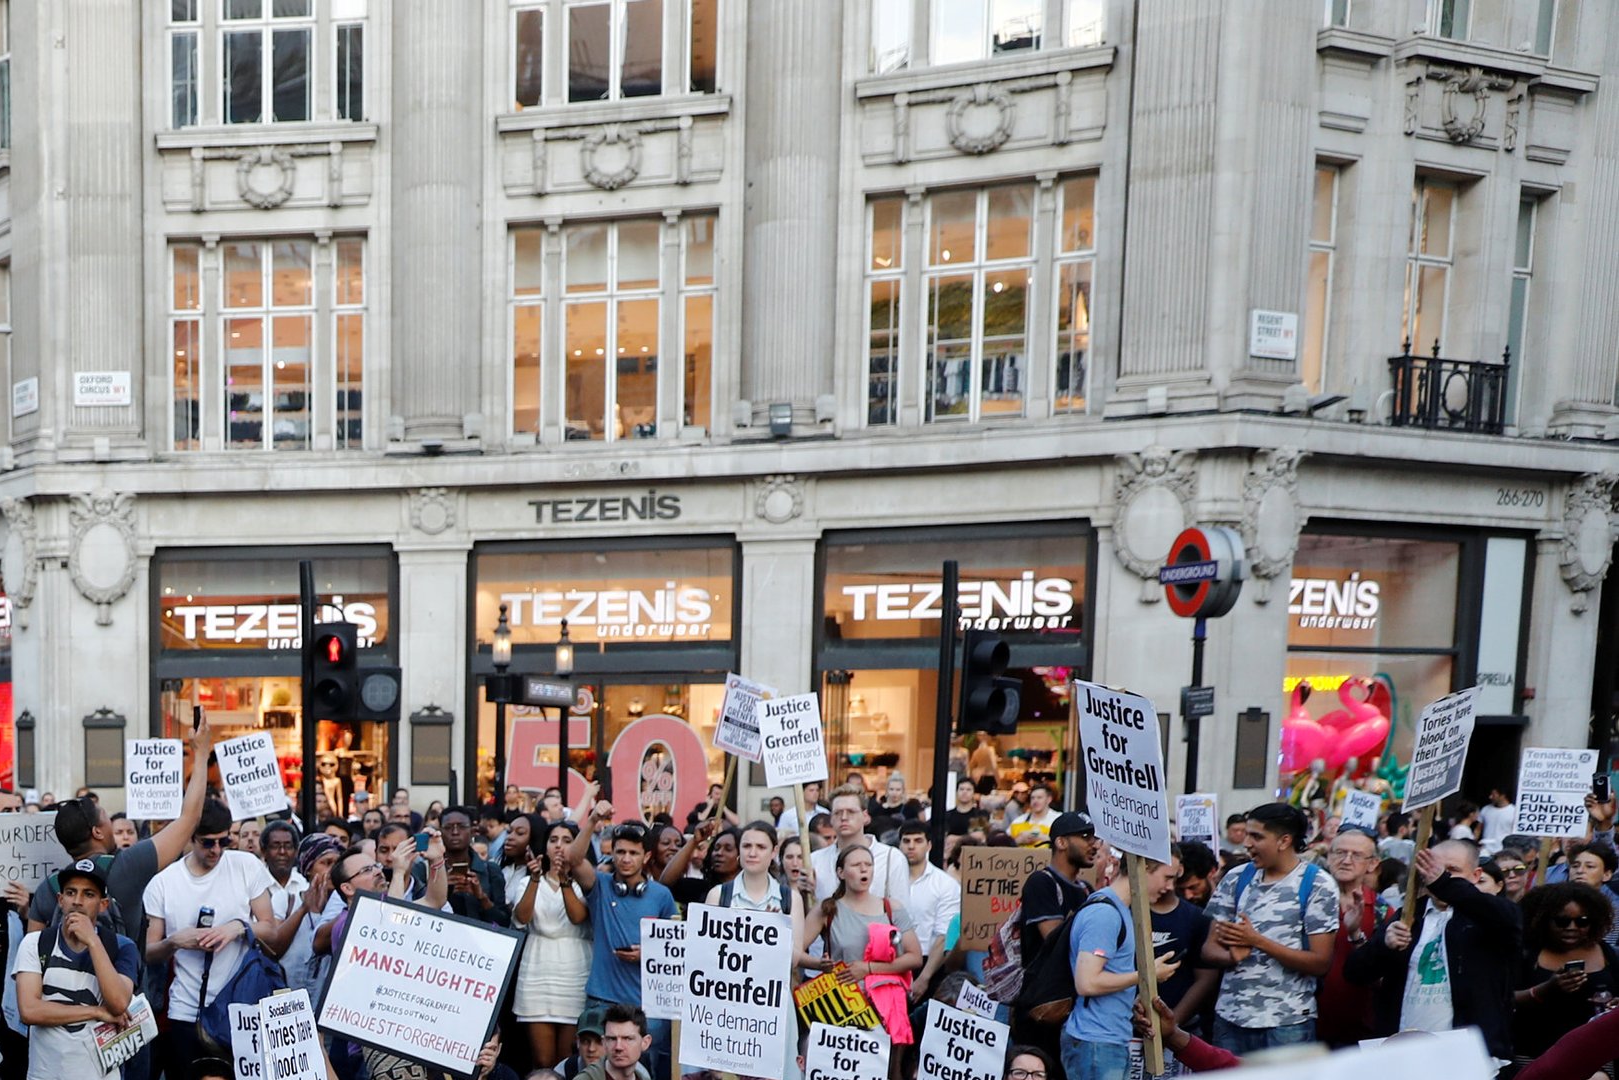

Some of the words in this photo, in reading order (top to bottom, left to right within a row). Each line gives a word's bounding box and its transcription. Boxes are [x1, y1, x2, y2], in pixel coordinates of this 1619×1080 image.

[79, 386, 110, 394] CIRCUS
[1496, 488, 1544, 507] 266-270
[1160, 564, 1216, 582] UNDERGROUND
[597, 621, 711, 637] underwear
[1300, 615, 1377, 629] underwear
[765, 699, 811, 717] Justice
[1085, 688, 1145, 730] Justice
[1422, 714, 1452, 732] Tories
[1454, 704, 1472, 721] have
[780, 716, 800, 731] for
[223, 737, 266, 757] Justice
[765, 727, 819, 750] Grenfell
[1102, 723, 1128, 755] for
[1415, 747, 1440, 763] their
[1441, 736, 1465, 755] hands
[1419, 728, 1446, 748] blood
[1524, 760, 1545, 769] die
[1546, 761, 1578, 770] when
[1526, 751, 1573, 760] Tenants
[1087, 746, 1159, 792] Grenfell
[1524, 769, 1579, 779] landlords
[1522, 779, 1554, 789] don't
[1091, 778, 1109, 802] We
[1111, 788, 1159, 820] demand
[1519, 804, 1585, 815] FUNDING
[1521, 794, 1555, 803] FULL
[1102, 807, 1121, 831] the
[1122, 814, 1151, 841] truth
[1517, 823, 1572, 833] SAFETY
[1518, 814, 1547, 823] FOR
[1551, 814, 1583, 824] FIRE
[12, 846, 26, 861] 4
[988, 854, 1020, 877] Tory
[967, 879, 996, 895] LET
[393, 911, 422, 927] THIS
[430, 919, 444, 933] IS
[649, 923, 686, 940] Justi
[698, 911, 778, 946] Justice
[359, 925, 406, 946] GROSS
[414, 940, 495, 971] NEGLIGENCE
[718, 944, 752, 973] for
[349, 946, 497, 1003] MANSLAUGHTER
[375, 985, 461, 1014] #JUSTICEFORGRENFELL
[689, 970, 782, 1008] Grenfell
[369, 1000, 438, 1024] #TORIESOUTNOW
[802, 983, 866, 1026] KILLS
[296, 1015, 312, 1043] have
[689, 1004, 713, 1026] We
[717, 1008, 778, 1036] demand
[934, 1008, 997, 1047] Justice
[325, 1003, 479, 1063] #INQUESTFORGRENFELL
[700, 1030, 722, 1052] the
[726, 1036, 762, 1058] truth
[817, 1028, 880, 1055] Justice
[946, 1037, 974, 1064] for
[833, 1052, 860, 1073] for
